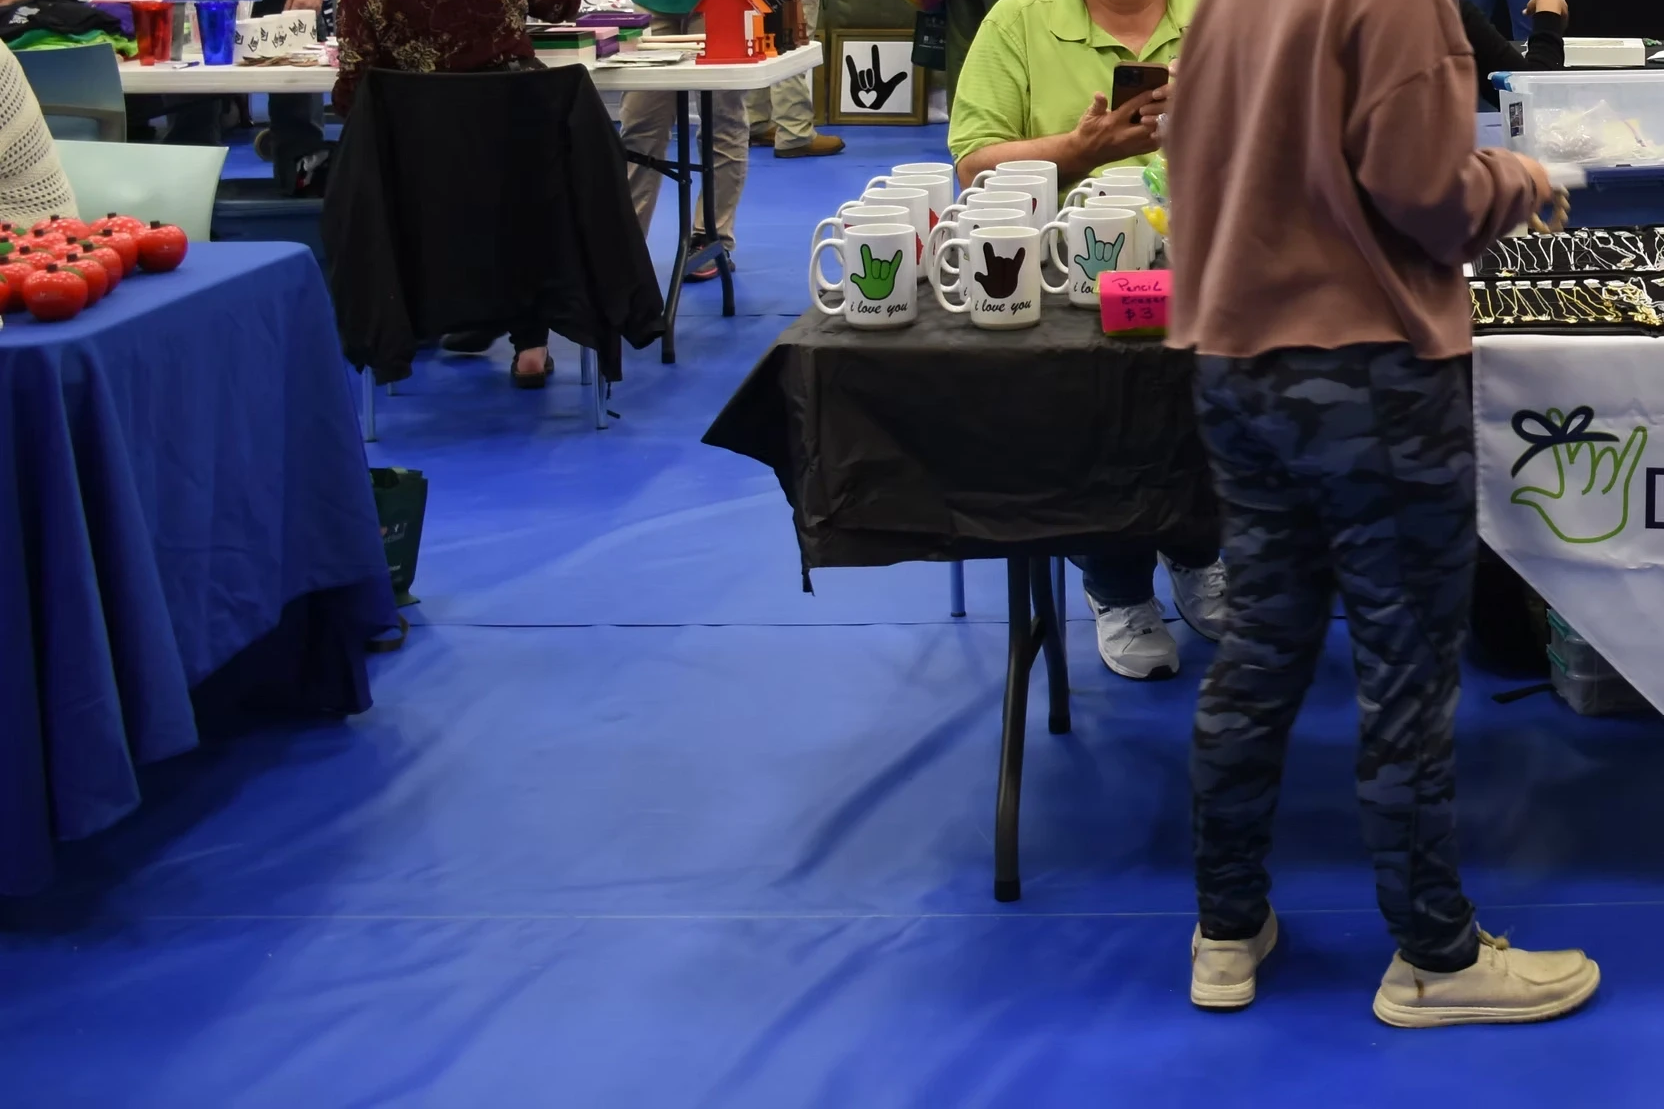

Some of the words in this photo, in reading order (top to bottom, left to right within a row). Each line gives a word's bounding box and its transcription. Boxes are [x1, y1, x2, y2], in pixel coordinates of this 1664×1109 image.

[850, 301, 855, 312] i
[857, 300, 882, 314] love
[886, 302, 908, 318] you
[975, 300, 979, 311] i
[982, 299, 1006, 312] love
[1011, 300, 1032, 316] you
